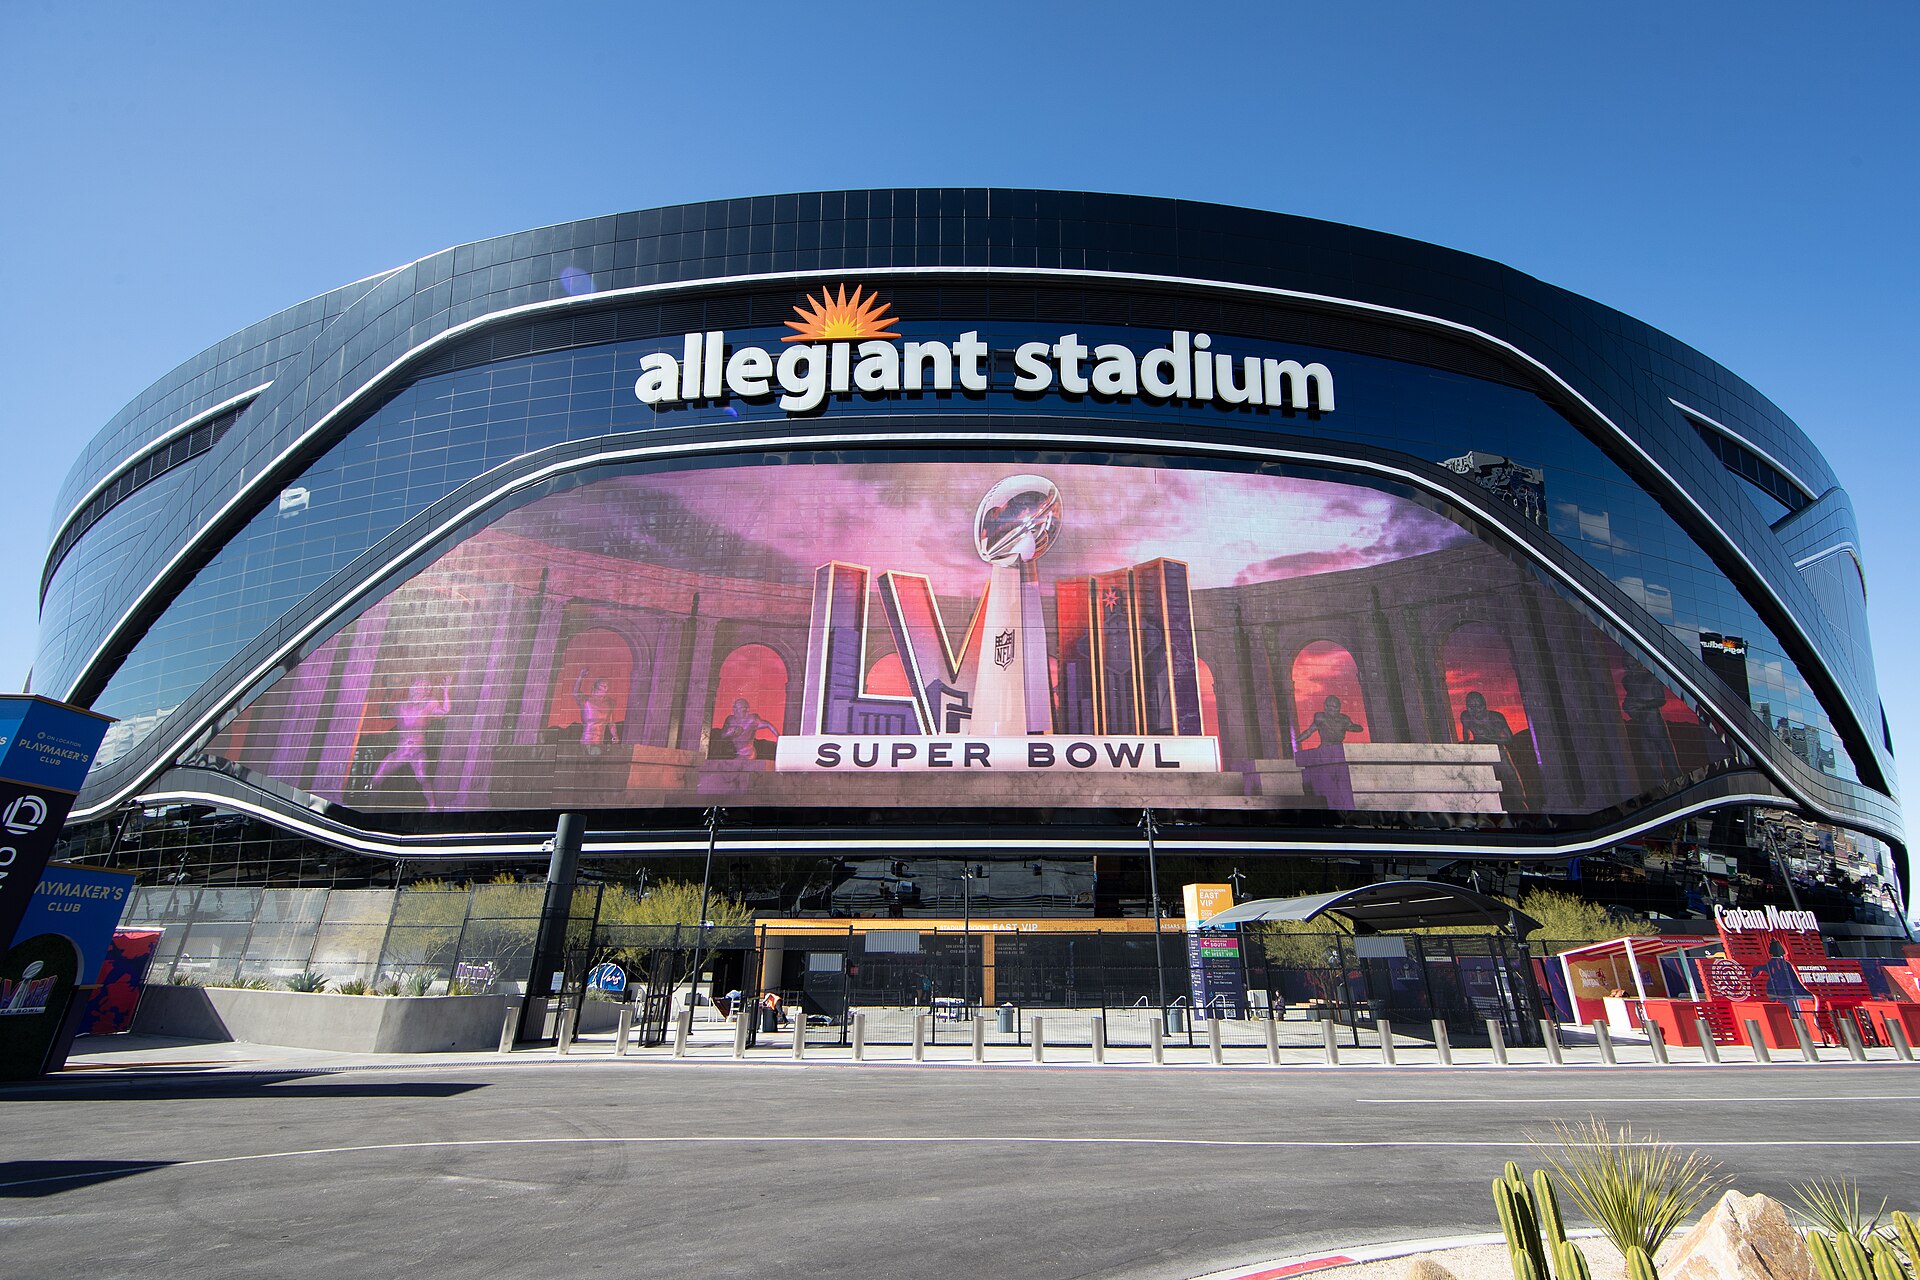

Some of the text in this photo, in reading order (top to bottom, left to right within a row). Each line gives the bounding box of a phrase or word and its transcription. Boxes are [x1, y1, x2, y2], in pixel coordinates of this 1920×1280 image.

[634, 330, 1335, 412] allegiant stadium
[18, 739, 89, 763] PLAYMAKER'S
[40, 756, 61, 766] CLUB
[815, 742, 1181, 768] SUPER BOWL
[34, 880, 124, 900] AYMAKER'S
[47, 902, 81, 912] CLUB
[992, 923, 1018, 931] EAST
[1021, 923, 1039, 932] VIP
[1714, 904, 1820, 934] Captain Morgan
